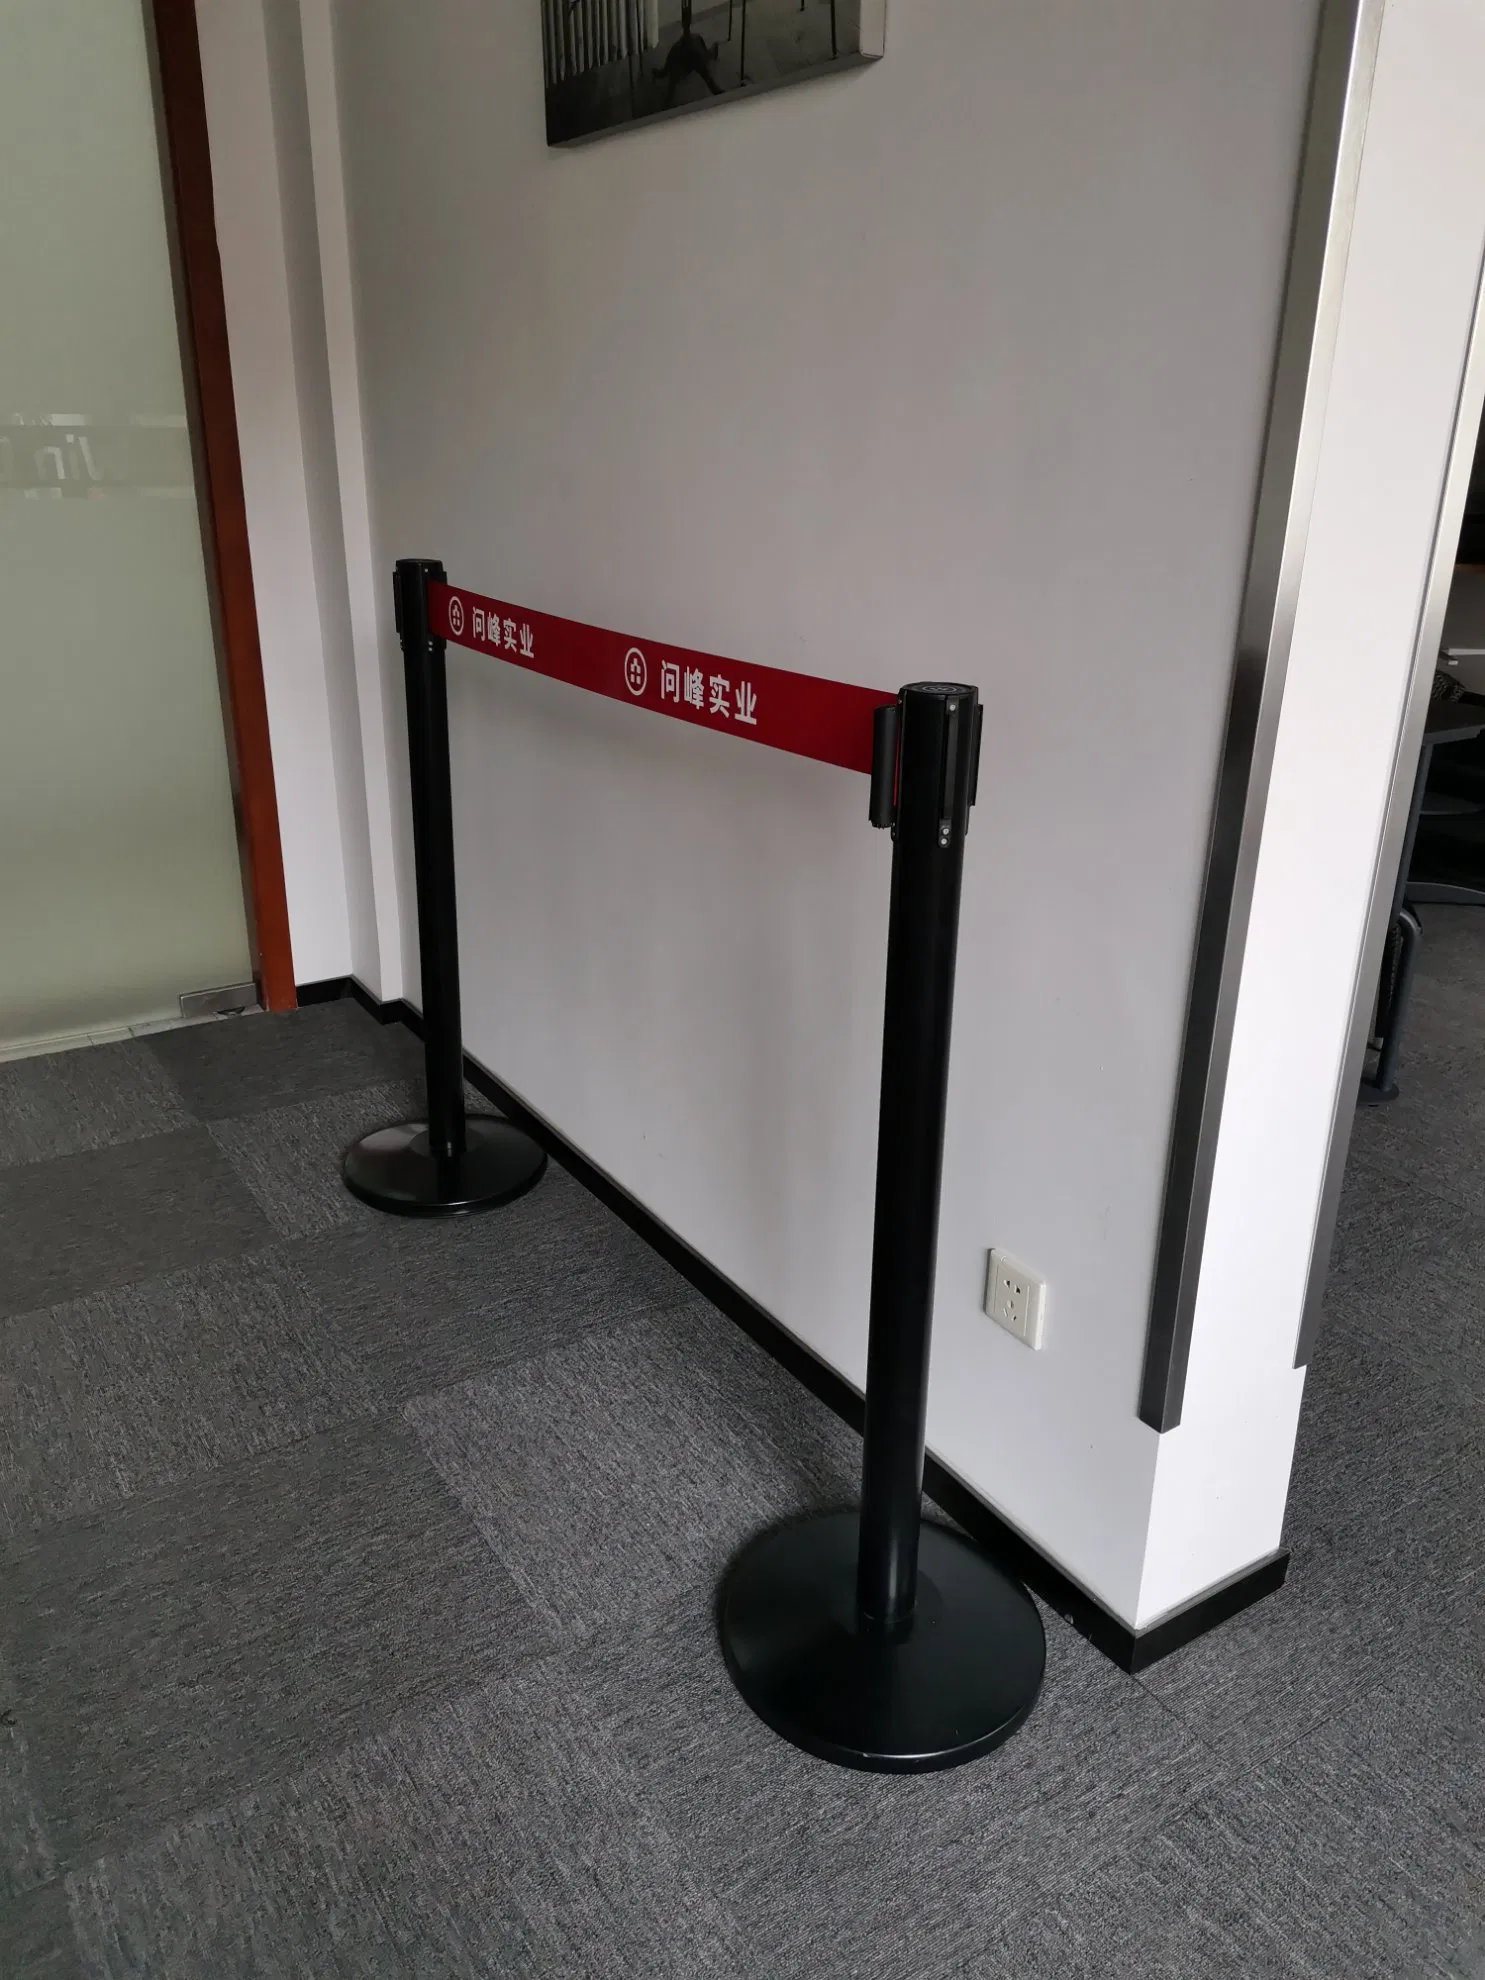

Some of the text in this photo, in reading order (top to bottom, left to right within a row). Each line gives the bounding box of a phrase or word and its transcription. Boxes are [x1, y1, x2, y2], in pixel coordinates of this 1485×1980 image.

[472, 606, 535, 658] 问峰实业
[660, 659, 757, 726] 问峰实业
